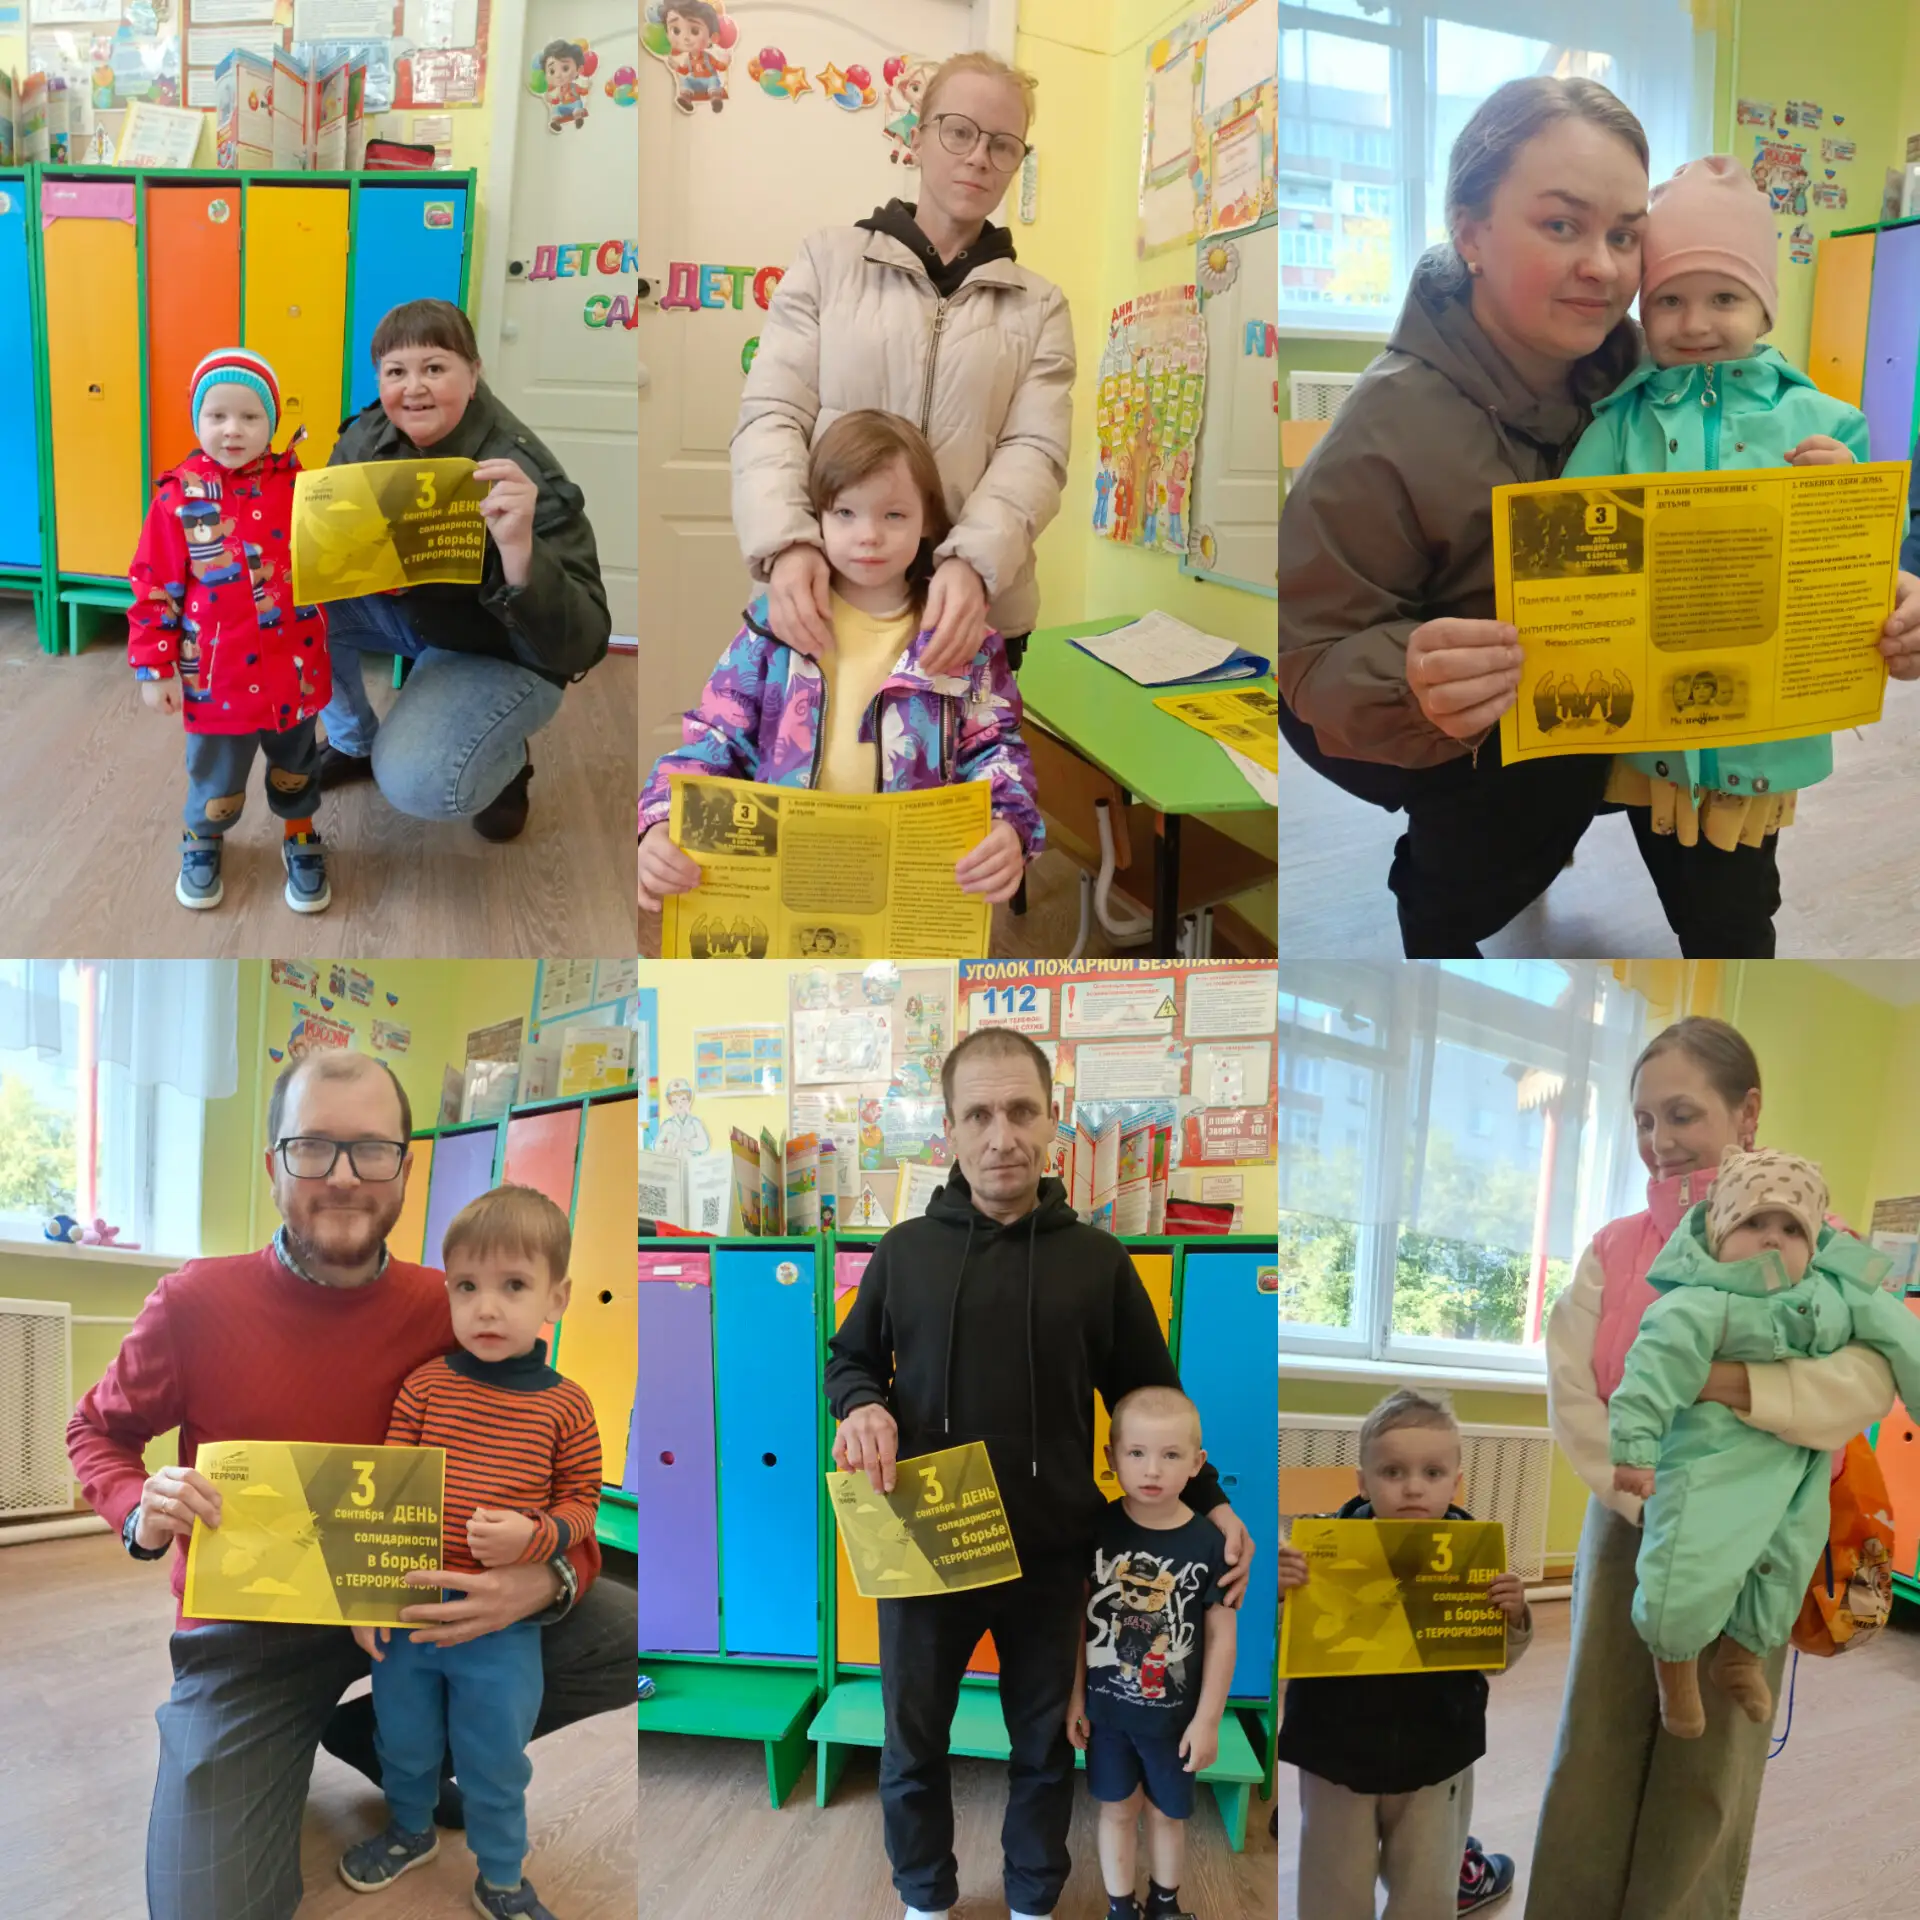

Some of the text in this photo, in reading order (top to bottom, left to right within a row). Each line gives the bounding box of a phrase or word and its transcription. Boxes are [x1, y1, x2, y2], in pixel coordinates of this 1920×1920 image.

[415, 472, 436, 508] 3
[1595, 507, 1606, 524] 3
[419, 522, 482, 534] солидарности
[428, 533, 481, 547] в борьбе
[412, 549, 480, 563] ТЕРРОРИЗМОМ
[1518, 596, 1560, 606] Памятка
[1571, 609, 1584, 617] по
[741, 805, 750, 819] 3
[966, 960, 1029, 981] УГОЛОК
[983, 983, 1036, 1014] 112
[1250, 1124, 1268, 1136] 101
[210, 1472, 249, 1481] ТЕРРОРА!
[351, 1461, 376, 1506] 3
[919, 1466, 944, 1504] 3
[916, 1486, 996, 1518] сентября ДЕНЬ
[334, 1505, 438, 1524] сентября ДЕНЬ
[936, 1507, 1001, 1532] солидарности
[354, 1532, 438, 1547] солидарности
[952, 1523, 1006, 1547] в борьбе
[933, 1539, 1011, 1566] с ТЕРРОРИЗМОМ
[1430, 1533, 1453, 1572] 3
[367, 1552, 438, 1571] в борьбе
[336, 1576, 343, 1586] с
[1432, 1592, 1489, 1602] солидарно
[1444, 1607, 1503, 1623] в борьбе
[1123, 1615, 1152, 1634] SKATE
[1416, 1626, 1503, 1639] с ТЕРРОРИЗМОМ
